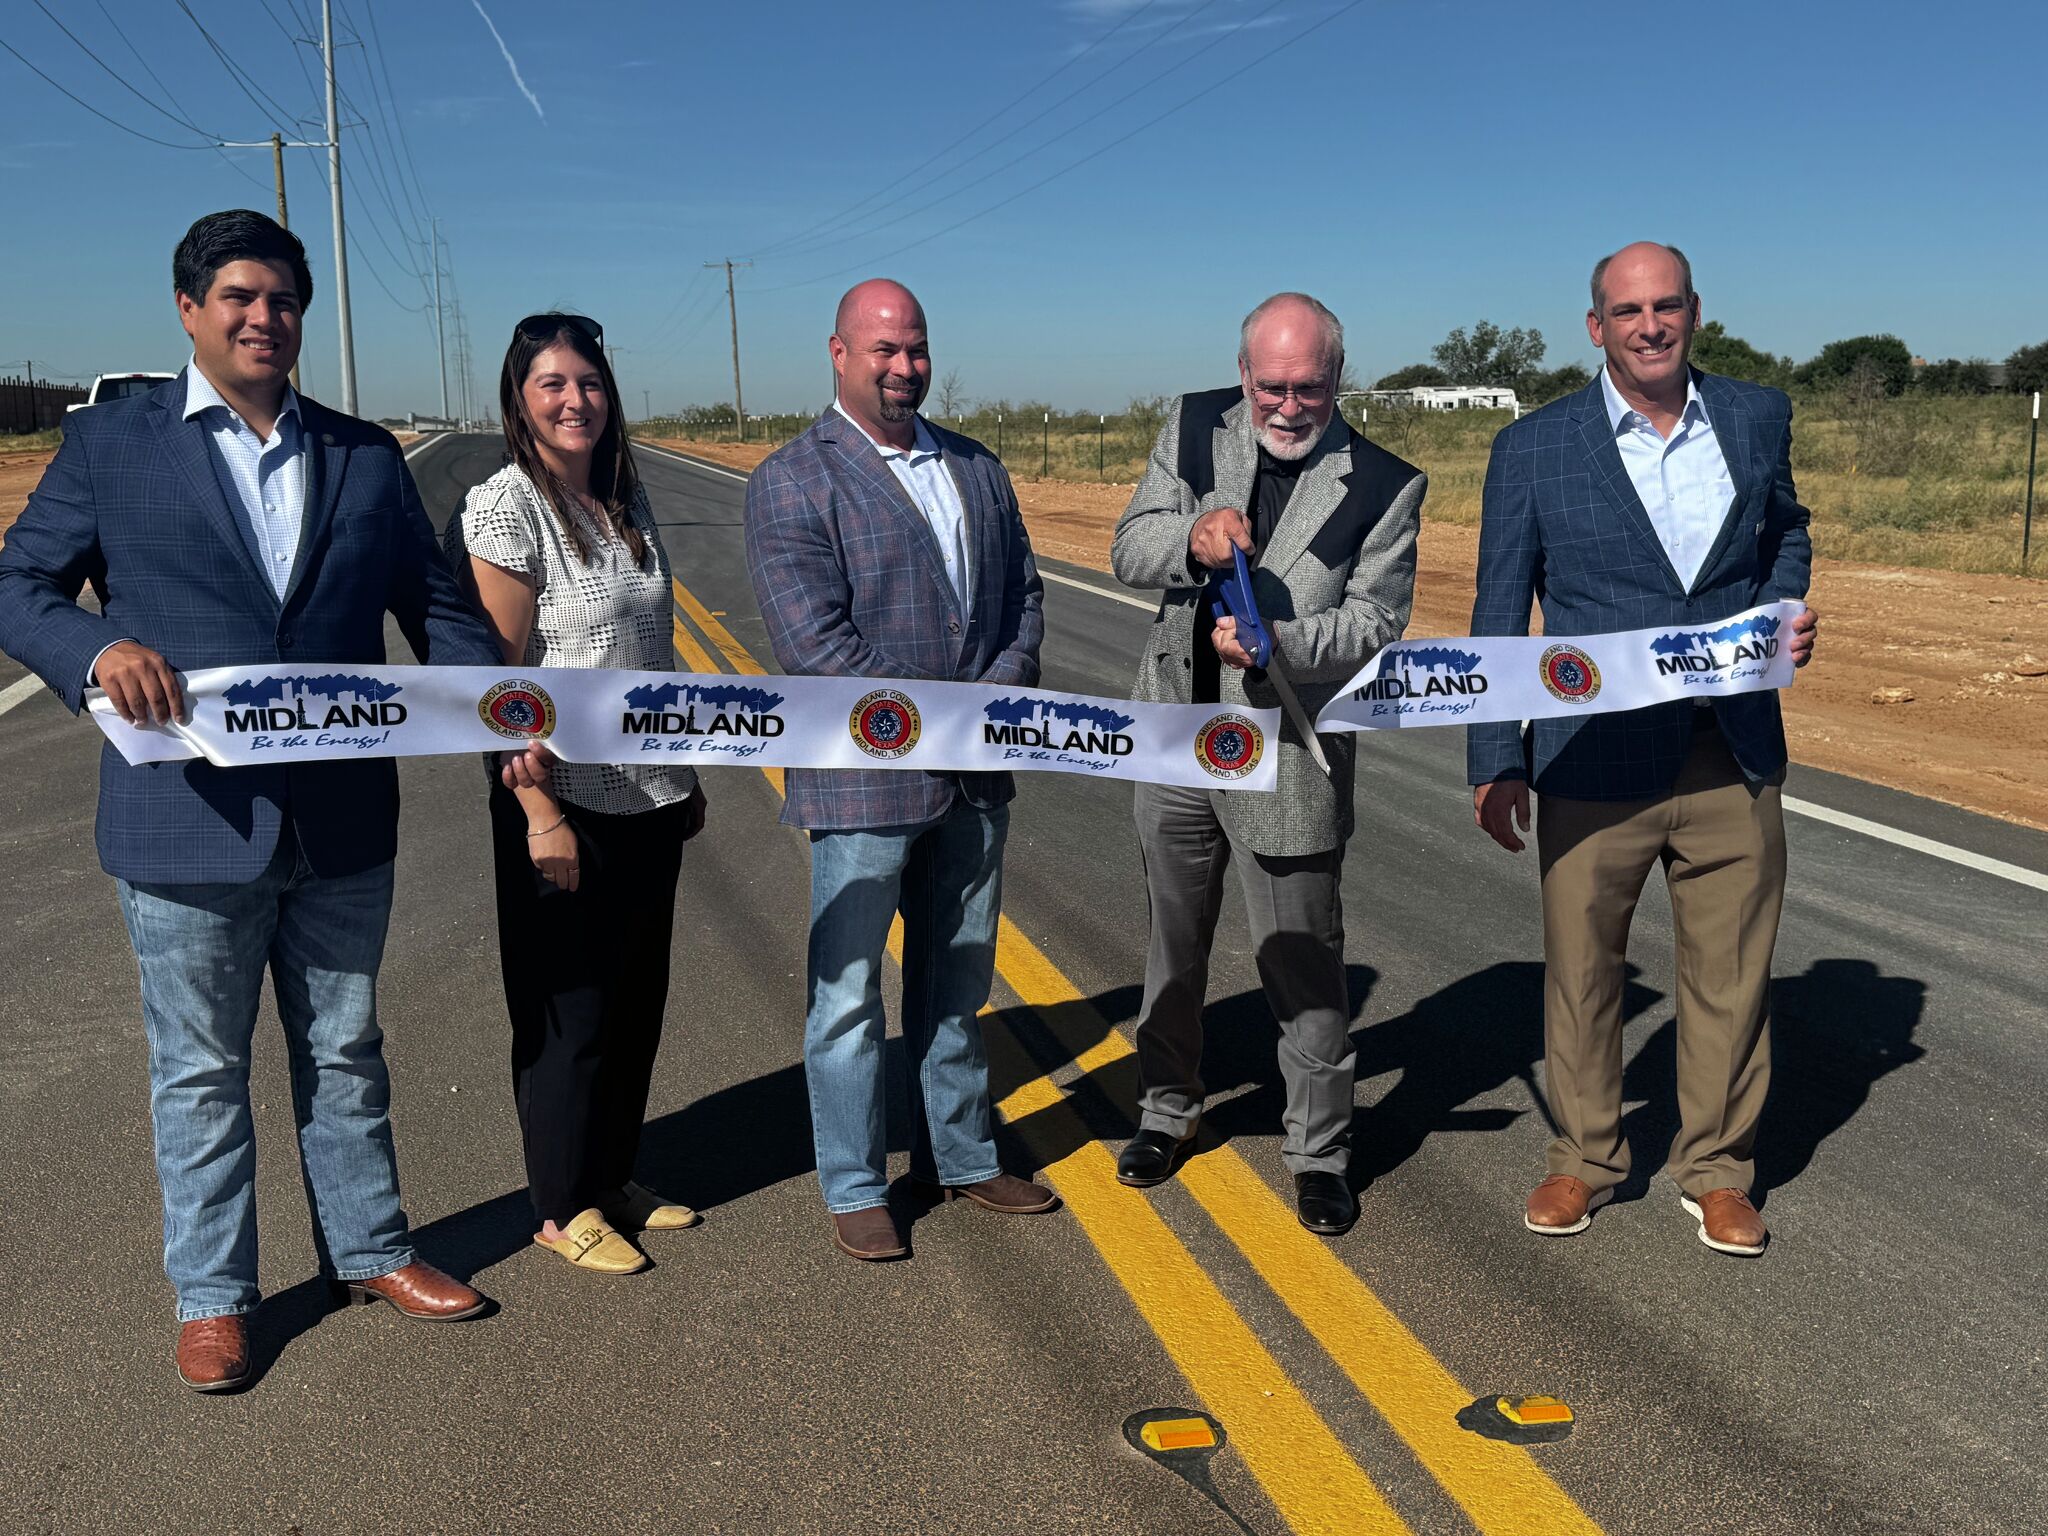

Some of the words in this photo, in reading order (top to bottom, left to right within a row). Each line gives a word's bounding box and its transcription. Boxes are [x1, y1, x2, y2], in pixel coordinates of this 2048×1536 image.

[1541, 645, 1563, 667] MIDLAND
[1564, 645, 1594, 666] COUNTY
[1656, 638, 1778, 676] MIDLAND
[1354, 669, 1488, 701] MIDLAND
[1683, 675, 1700, 685] Be
[1704, 674, 1724, 684] the
[482, 681, 517, 706] MIDLAND
[520, 681, 552, 707] COUNTY
[854, 691, 887, 715] MIDLAND
[889, 691, 918, 717] COUNTY
[224, 698, 408, 733] MIDLAND
[871, 701, 893, 711] STATE
[1371, 704, 1388, 716] Be
[1393, 702, 1414, 714] the
[1420, 698, 1477, 715] Energy!
[621, 704, 785, 738] MIDLAND
[1200, 714, 1233, 737] MIDLAND
[1235, 715, 1262, 738] COUNTY
[1216, 723, 1238, 733] STATE
[250, 736, 273, 750] Be
[279, 735, 309, 748] the
[315, 730, 390, 749] Energy!
[640, 738, 664, 751] Be
[667, 740, 693, 752] the
[698, 739, 767, 757] Energy!
[852, 733, 891, 758] MIDLAND,
[892, 737, 916, 757] TEXAS
[874, 740, 897, 749] TEXAS
[984, 720, 1134, 756] MIDLAND
[1003, 748, 1024, 760] Be
[1027, 750, 1052, 761] the
[1057, 754, 1118, 770] Energy!
[1197, 754, 1233, 778] MIDLAND,
[1234, 758, 1259, 777] TEXAS
[1217, 760, 1240, 769] TEXAS
